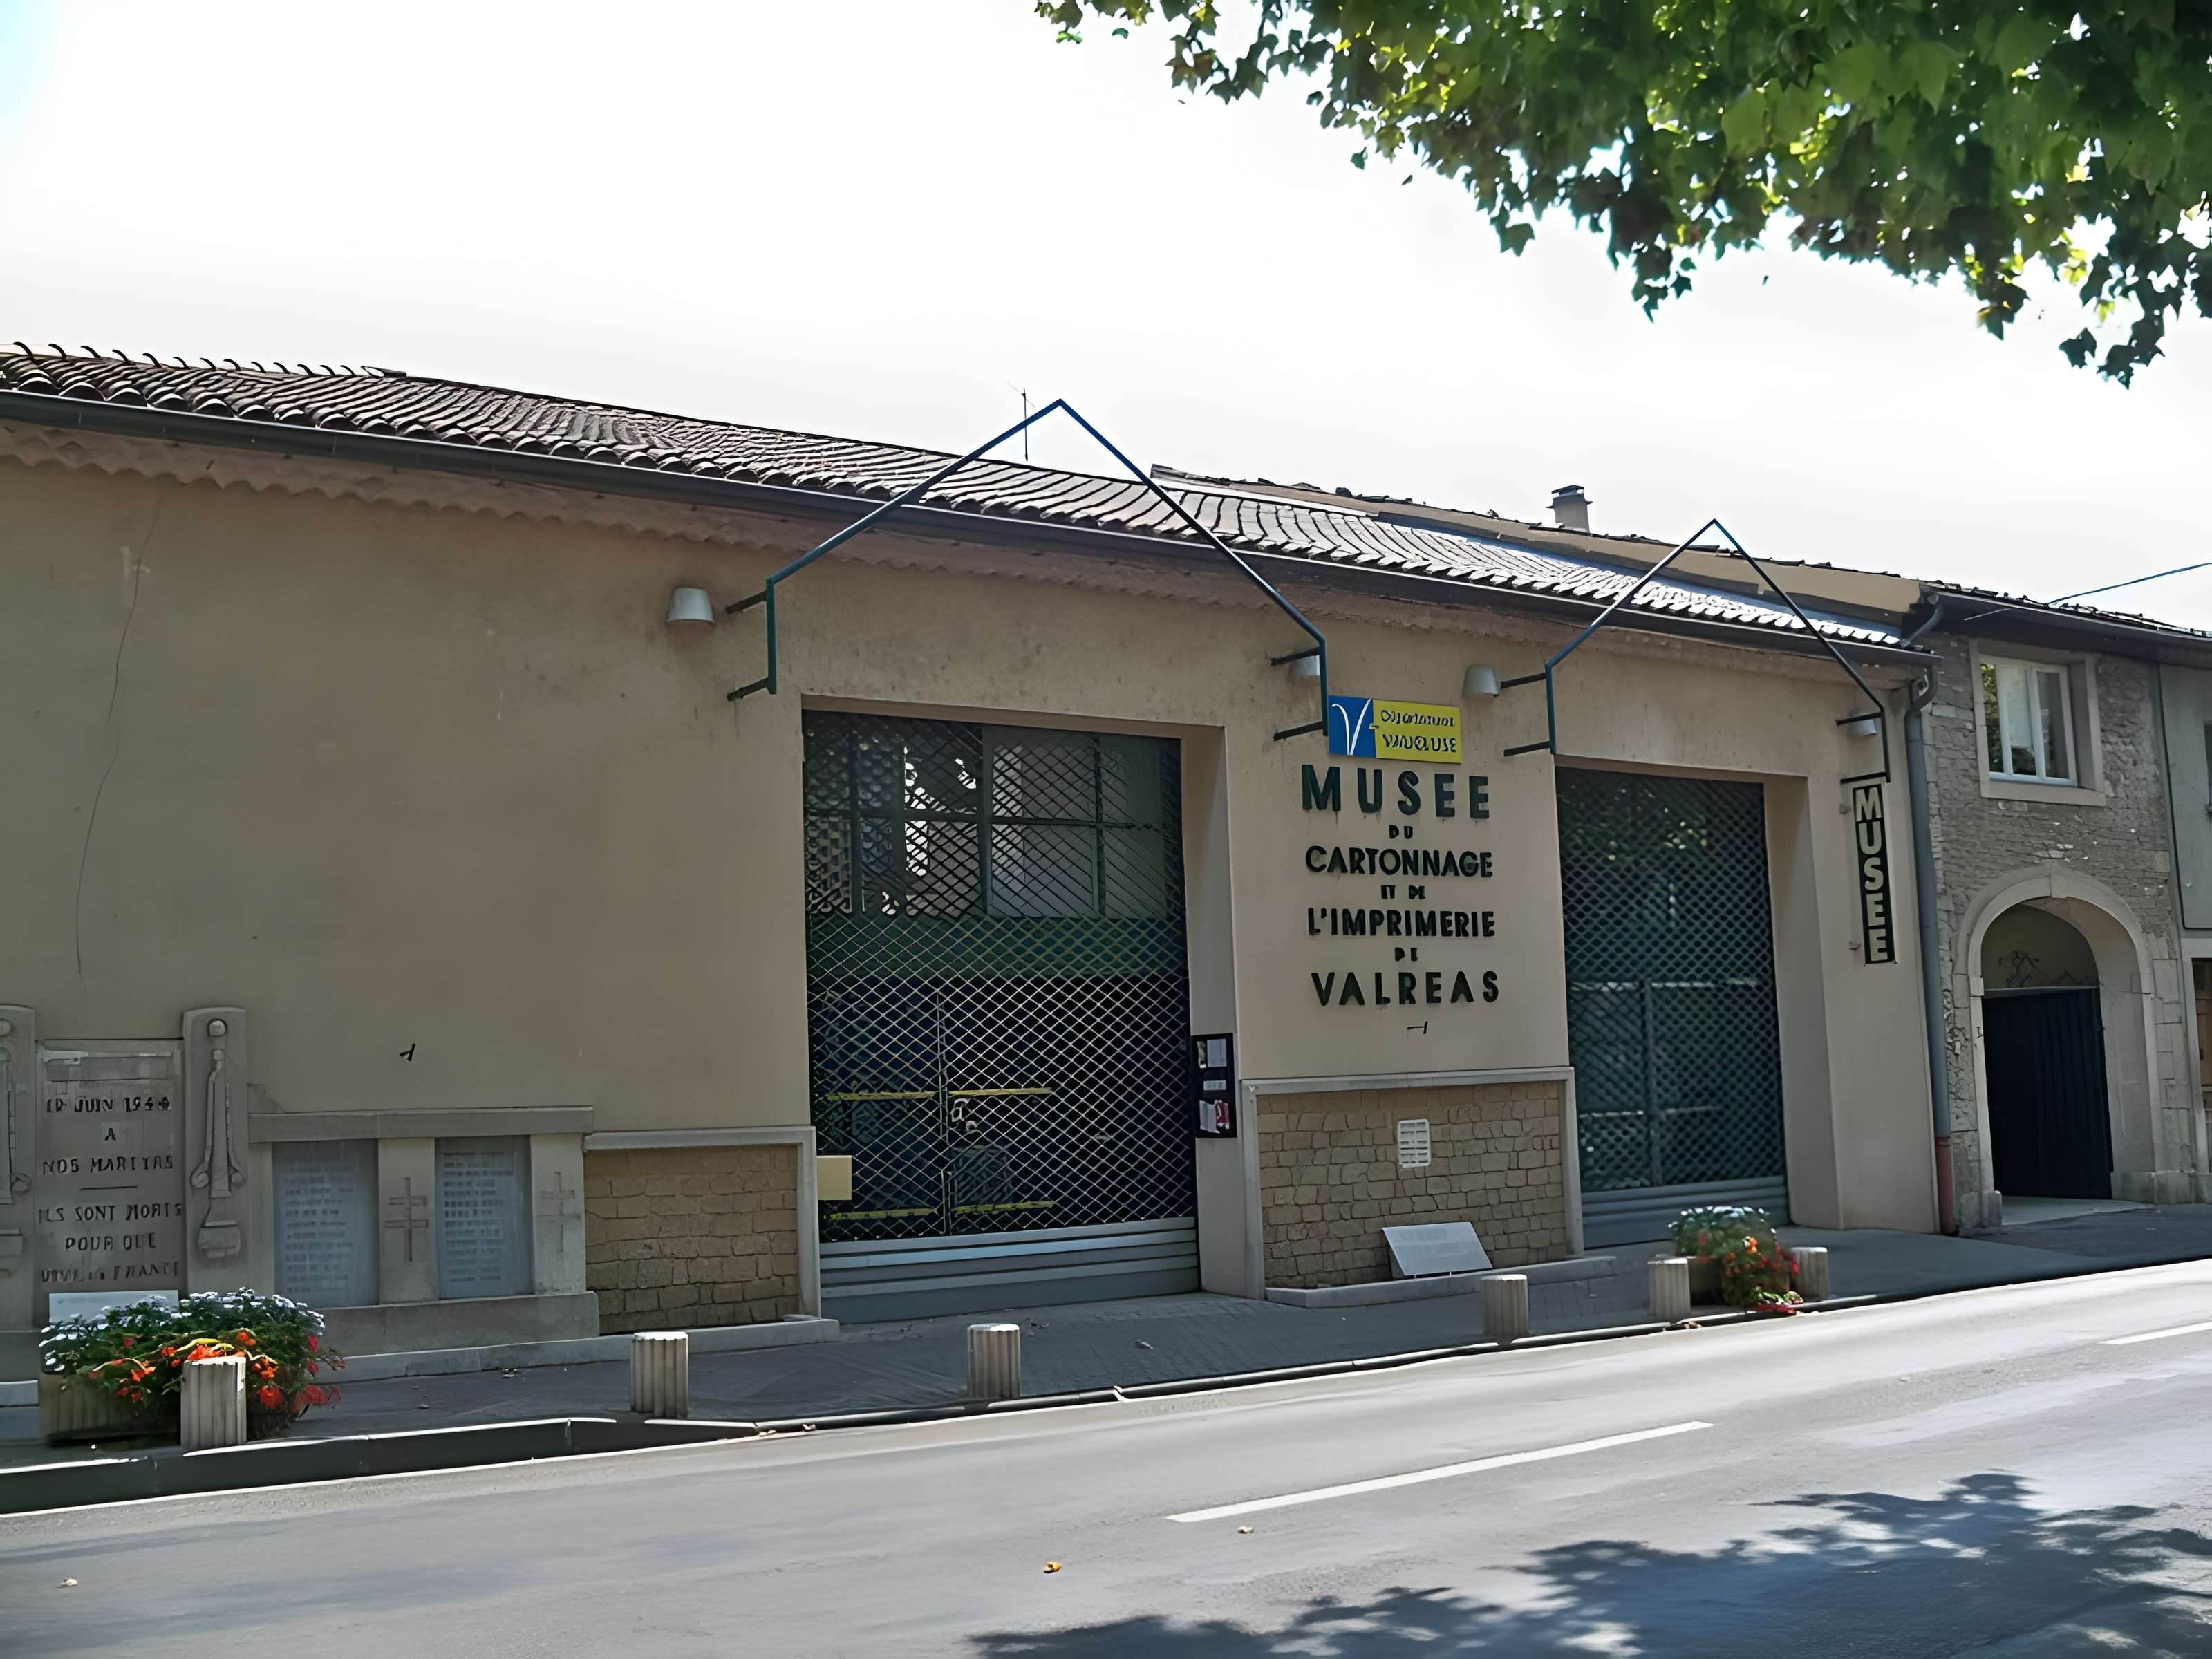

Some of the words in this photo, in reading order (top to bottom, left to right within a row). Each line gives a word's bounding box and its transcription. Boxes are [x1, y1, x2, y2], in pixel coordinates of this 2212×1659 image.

[1301, 764, 1490, 819] MUSEE
[1389, 824, 1414, 840] DU
[1305, 845, 1493, 878] CARTONNAGE
[1855, 785, 1889, 963] MUSEE
[1408, 885, 1427, 900] DE
[1307, 907, 1495, 937] L'IMPRIMERIE
[1394, 947, 1418, 962] DE
[1311, 970, 1499, 1007] VALREAS
[74, 1098, 114, 1112] JUIN
[43, 1158, 79, 1175] NOS
[38, 1208, 64, 1224] ILS
[75, 1205, 116, 1222] SONT
[125, 1203, 184, 1221] MORTS
[65, 1236, 113, 1251] POUR
